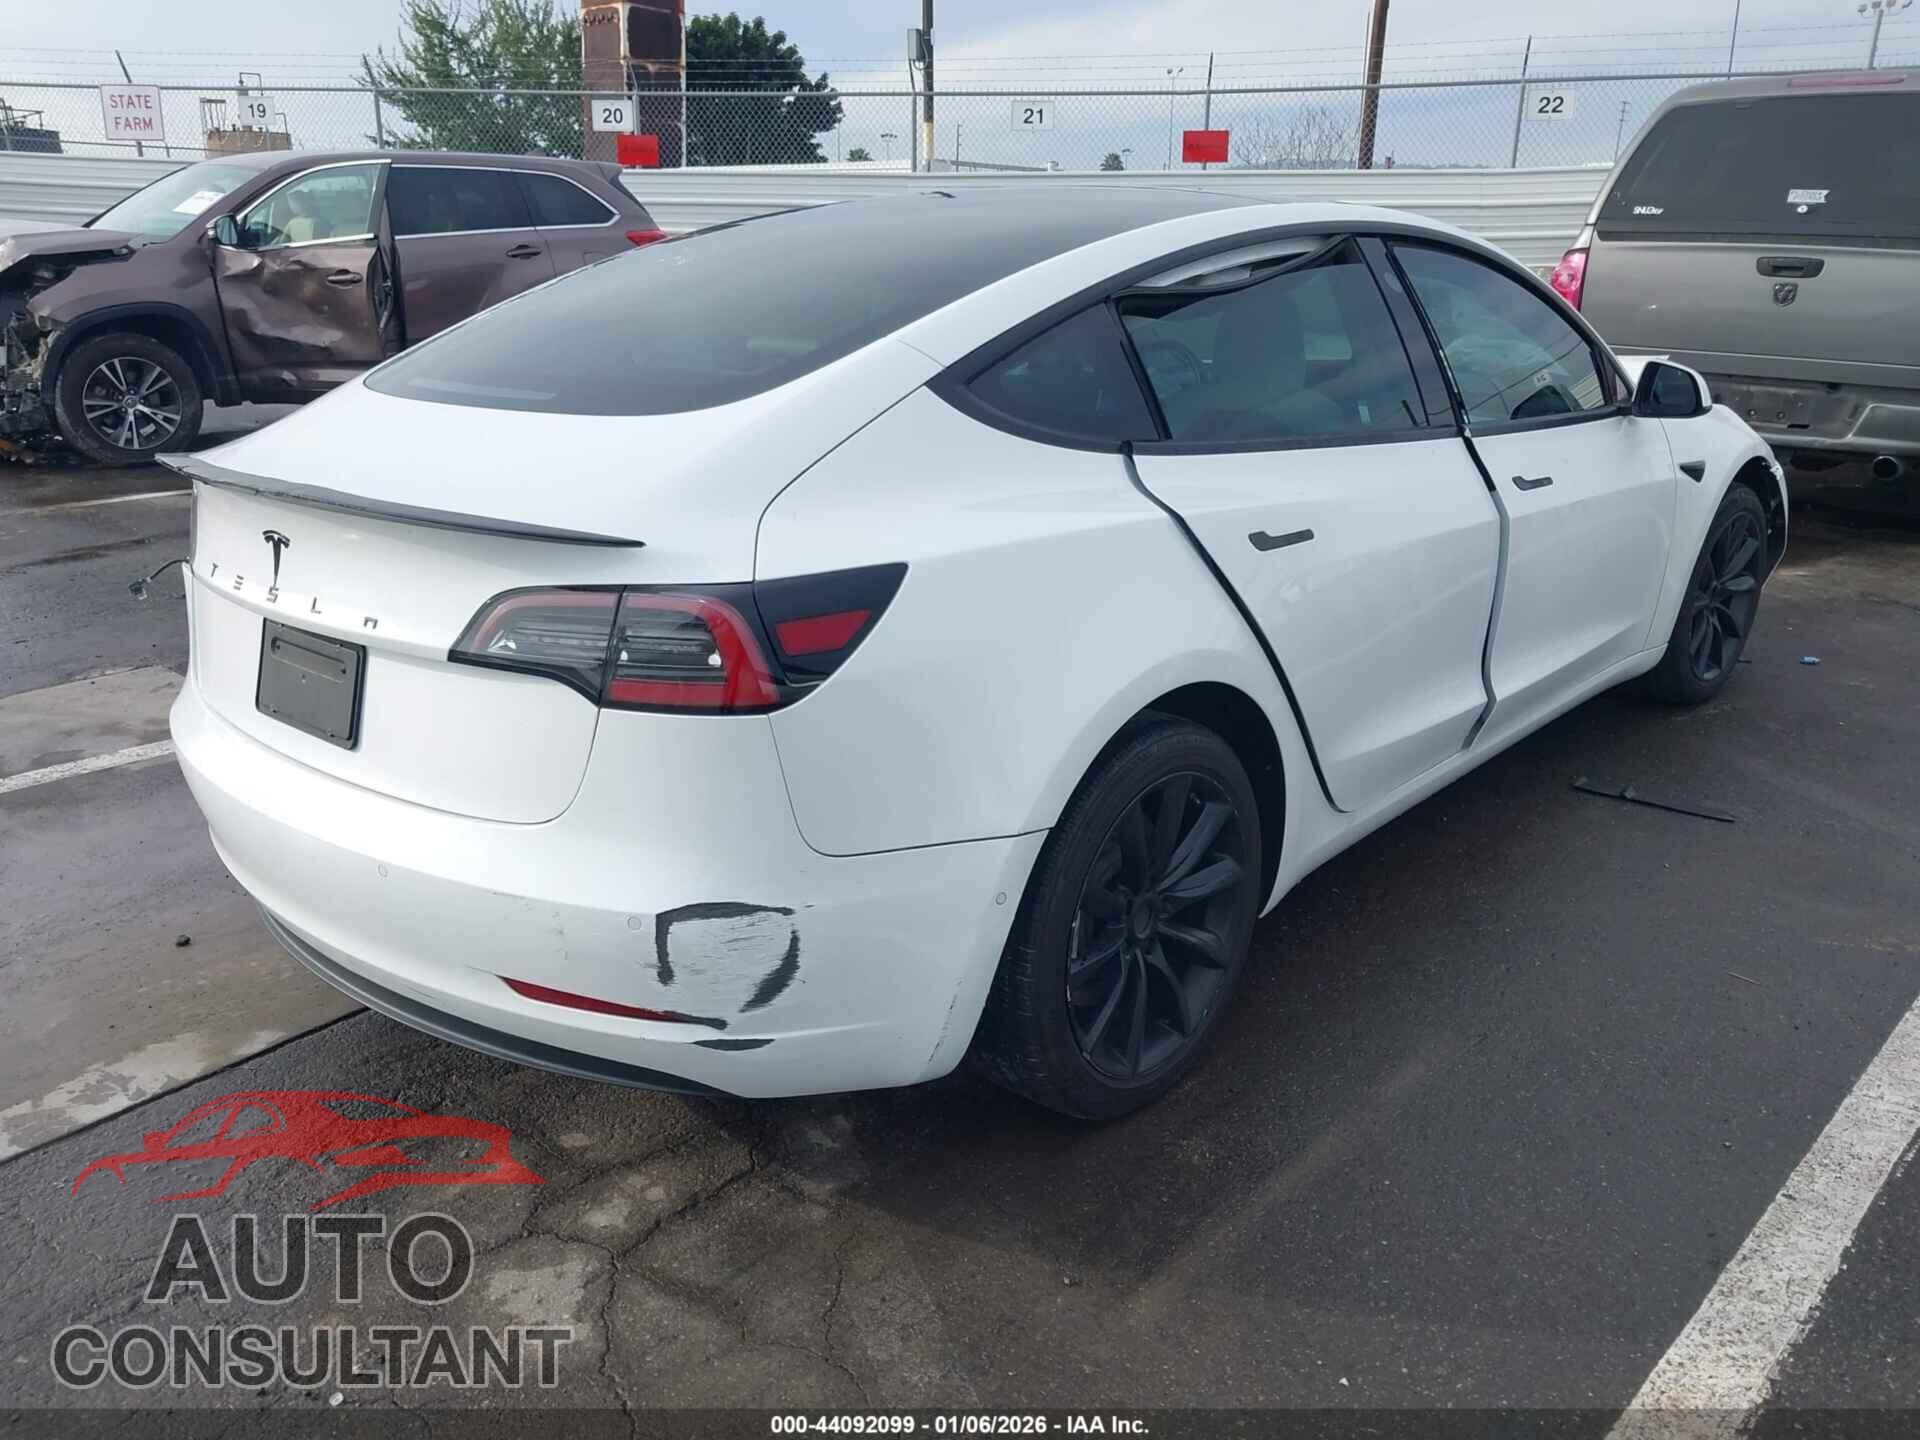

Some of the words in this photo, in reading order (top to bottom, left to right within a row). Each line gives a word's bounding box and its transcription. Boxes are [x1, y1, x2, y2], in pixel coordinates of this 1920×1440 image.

[110, 94, 153, 110] STATE
[1537, 96, 1564, 114] 22
[248, 103, 267, 118] 19
[602, 107, 623, 124] 20
[1023, 108, 1044, 124] 21
[114, 116, 154, 131] FARM
